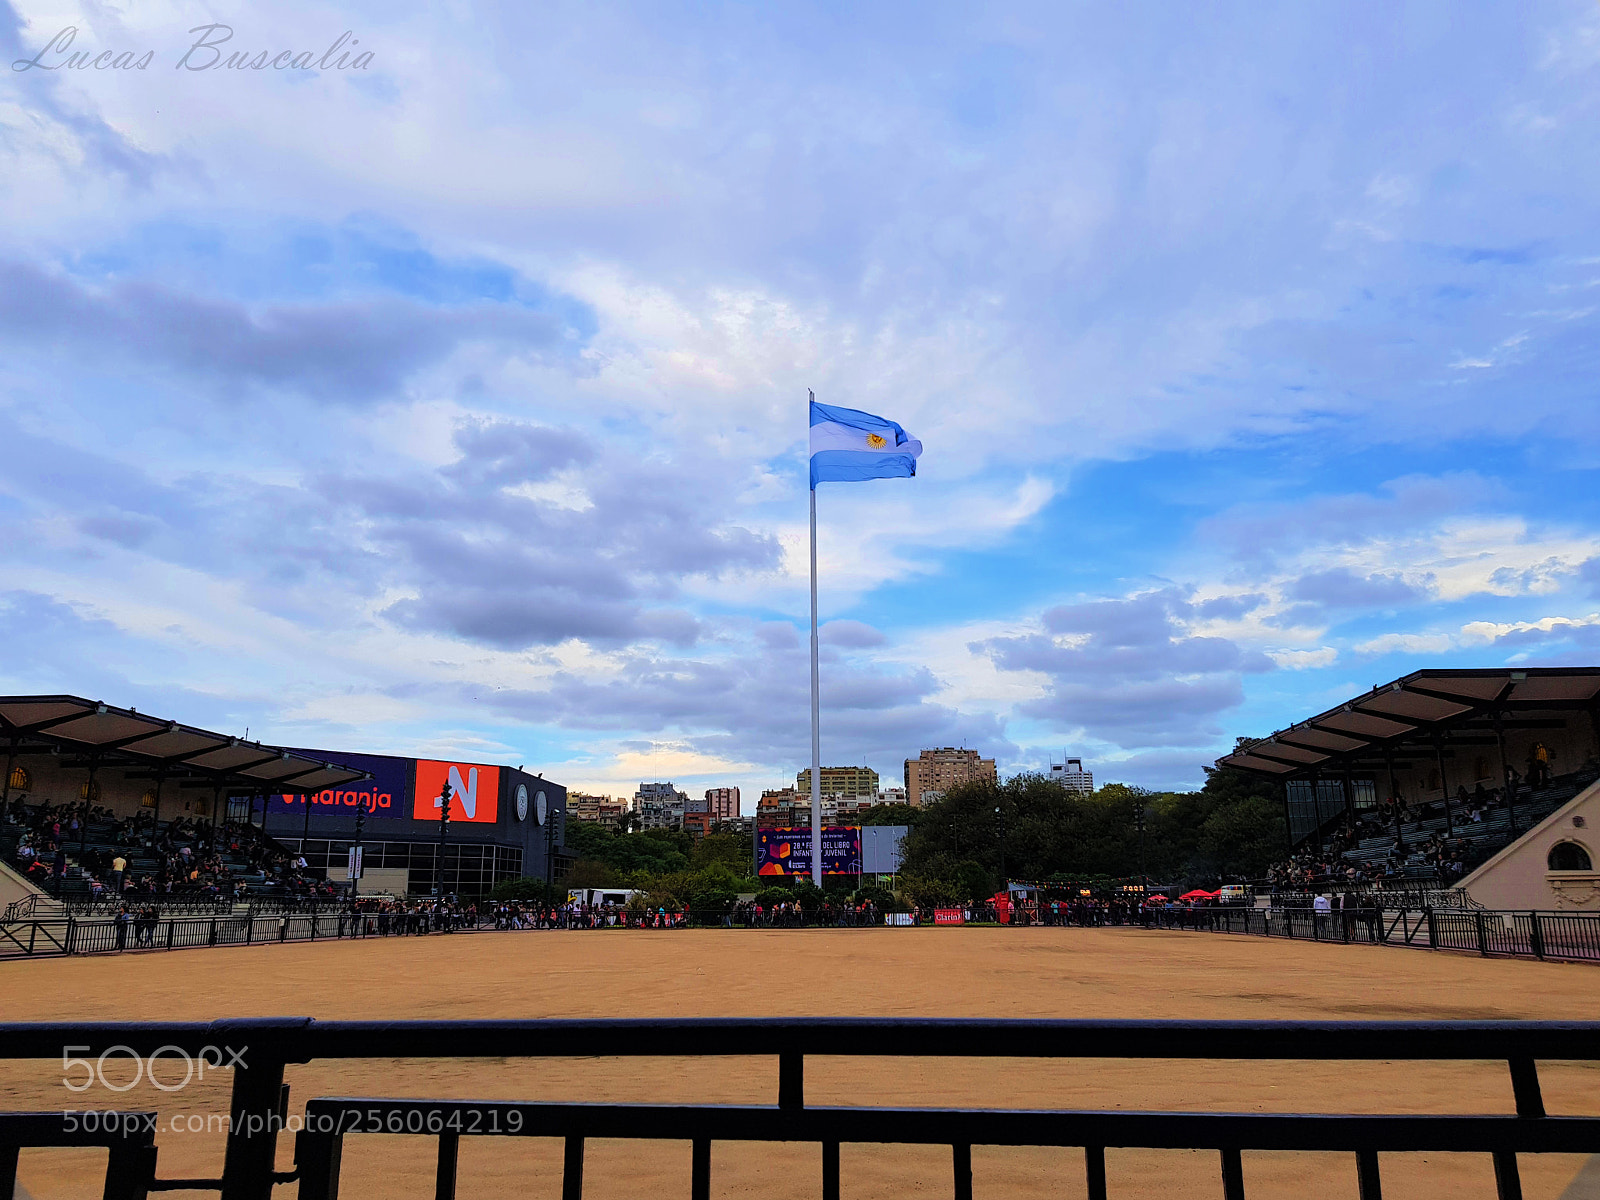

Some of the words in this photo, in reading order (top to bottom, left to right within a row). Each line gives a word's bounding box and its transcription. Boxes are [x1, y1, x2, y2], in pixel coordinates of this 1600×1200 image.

[823, 841, 833, 849] DEL
[834, 841, 851, 849] LIBRO
[824, 849, 847, 857] JUVENIL
